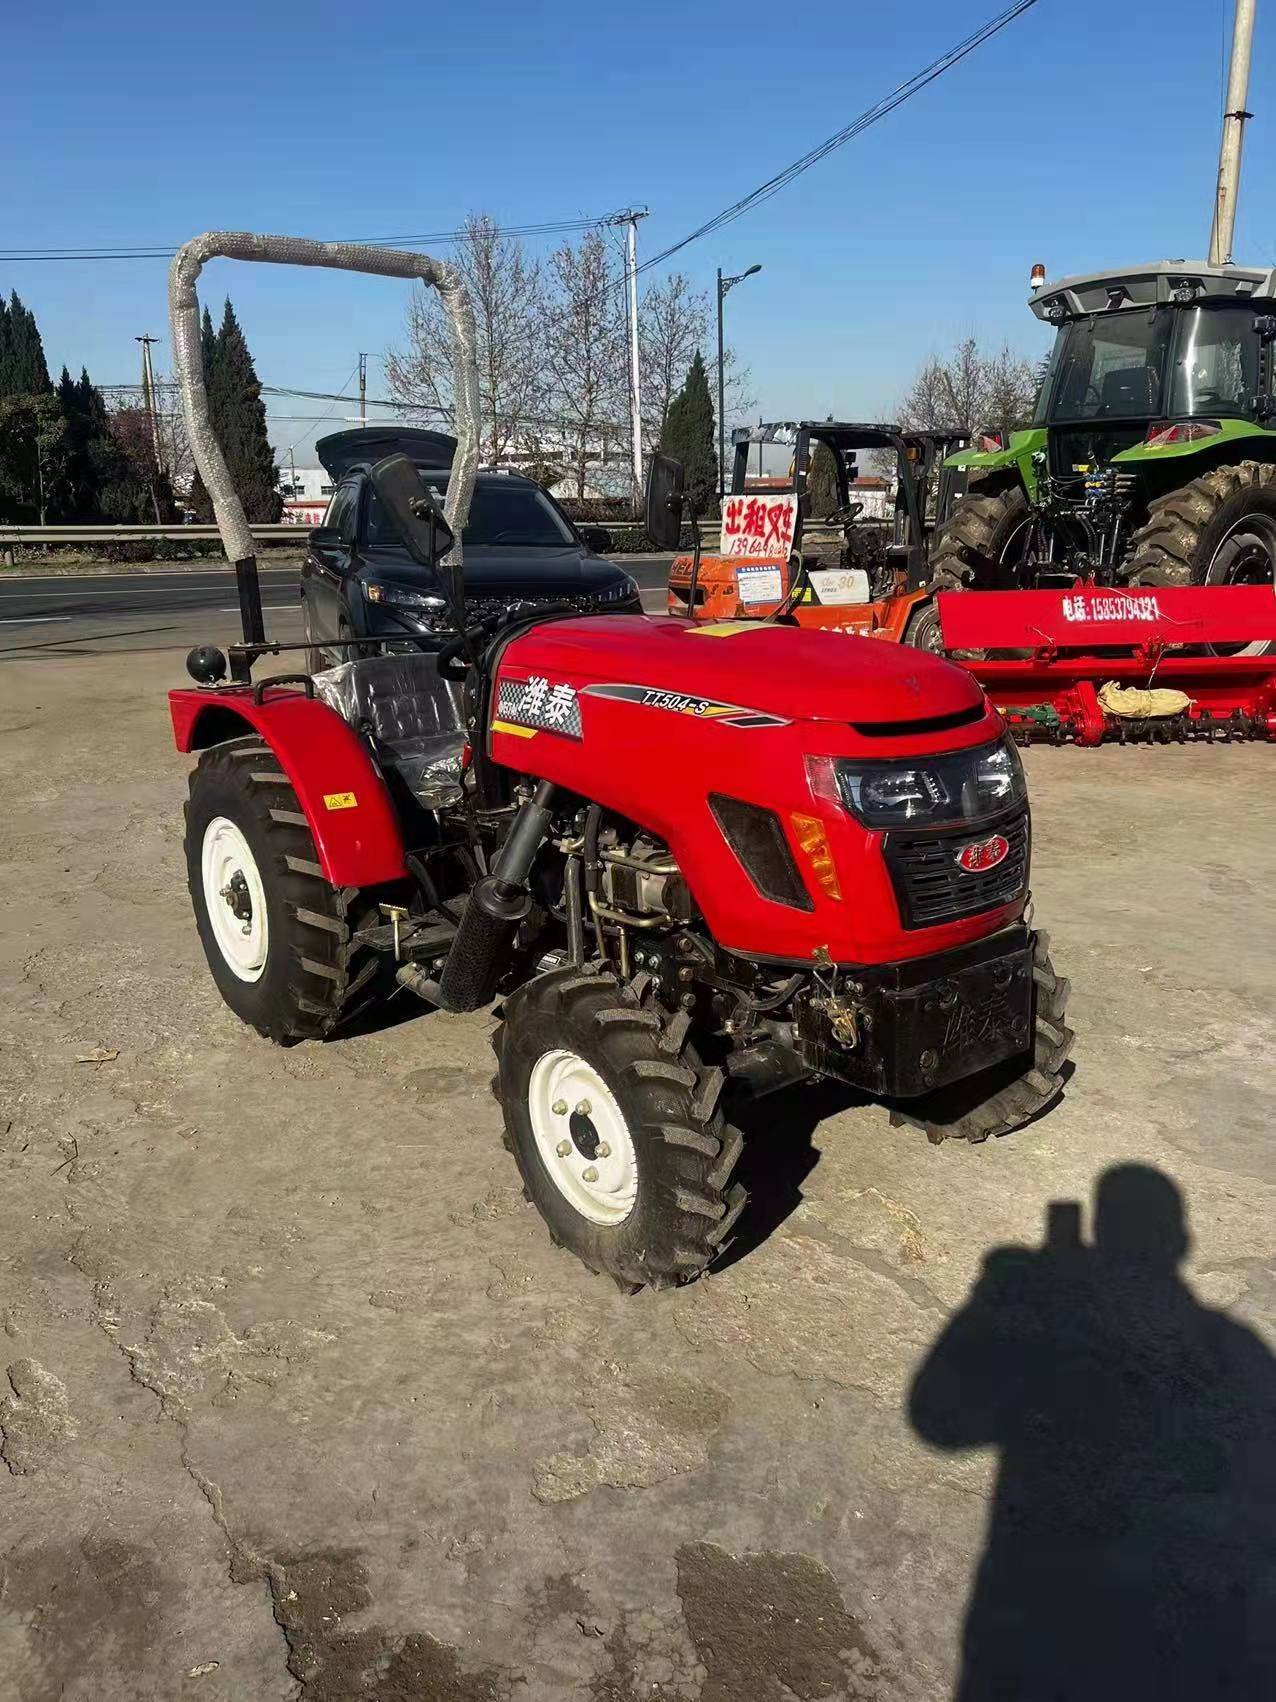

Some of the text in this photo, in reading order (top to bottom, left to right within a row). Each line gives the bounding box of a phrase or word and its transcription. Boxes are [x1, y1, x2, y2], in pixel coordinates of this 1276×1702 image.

[726, 498, 793, 544] 出租叉车
[641, 690, 710, 714] TT504-S
